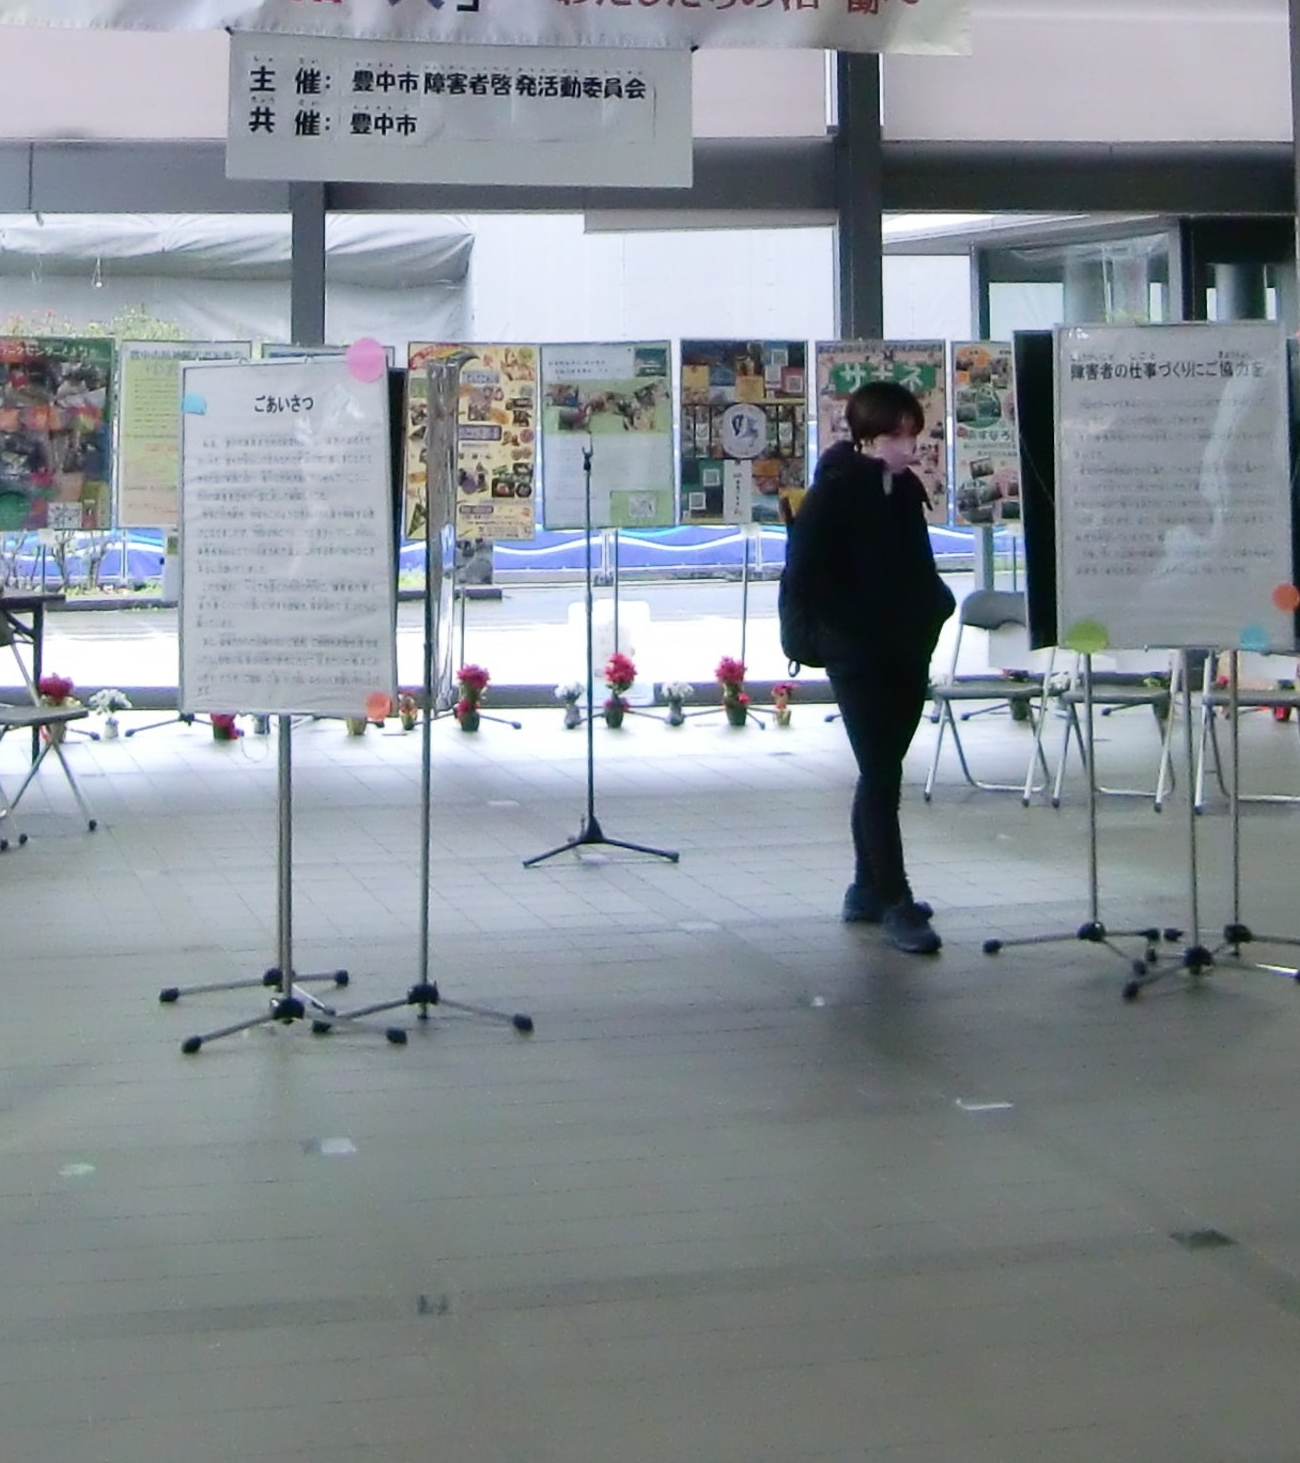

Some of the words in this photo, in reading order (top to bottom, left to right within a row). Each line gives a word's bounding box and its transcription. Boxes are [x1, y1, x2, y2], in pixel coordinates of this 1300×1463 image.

[253, 393, 315, 414] ごあいさつ
